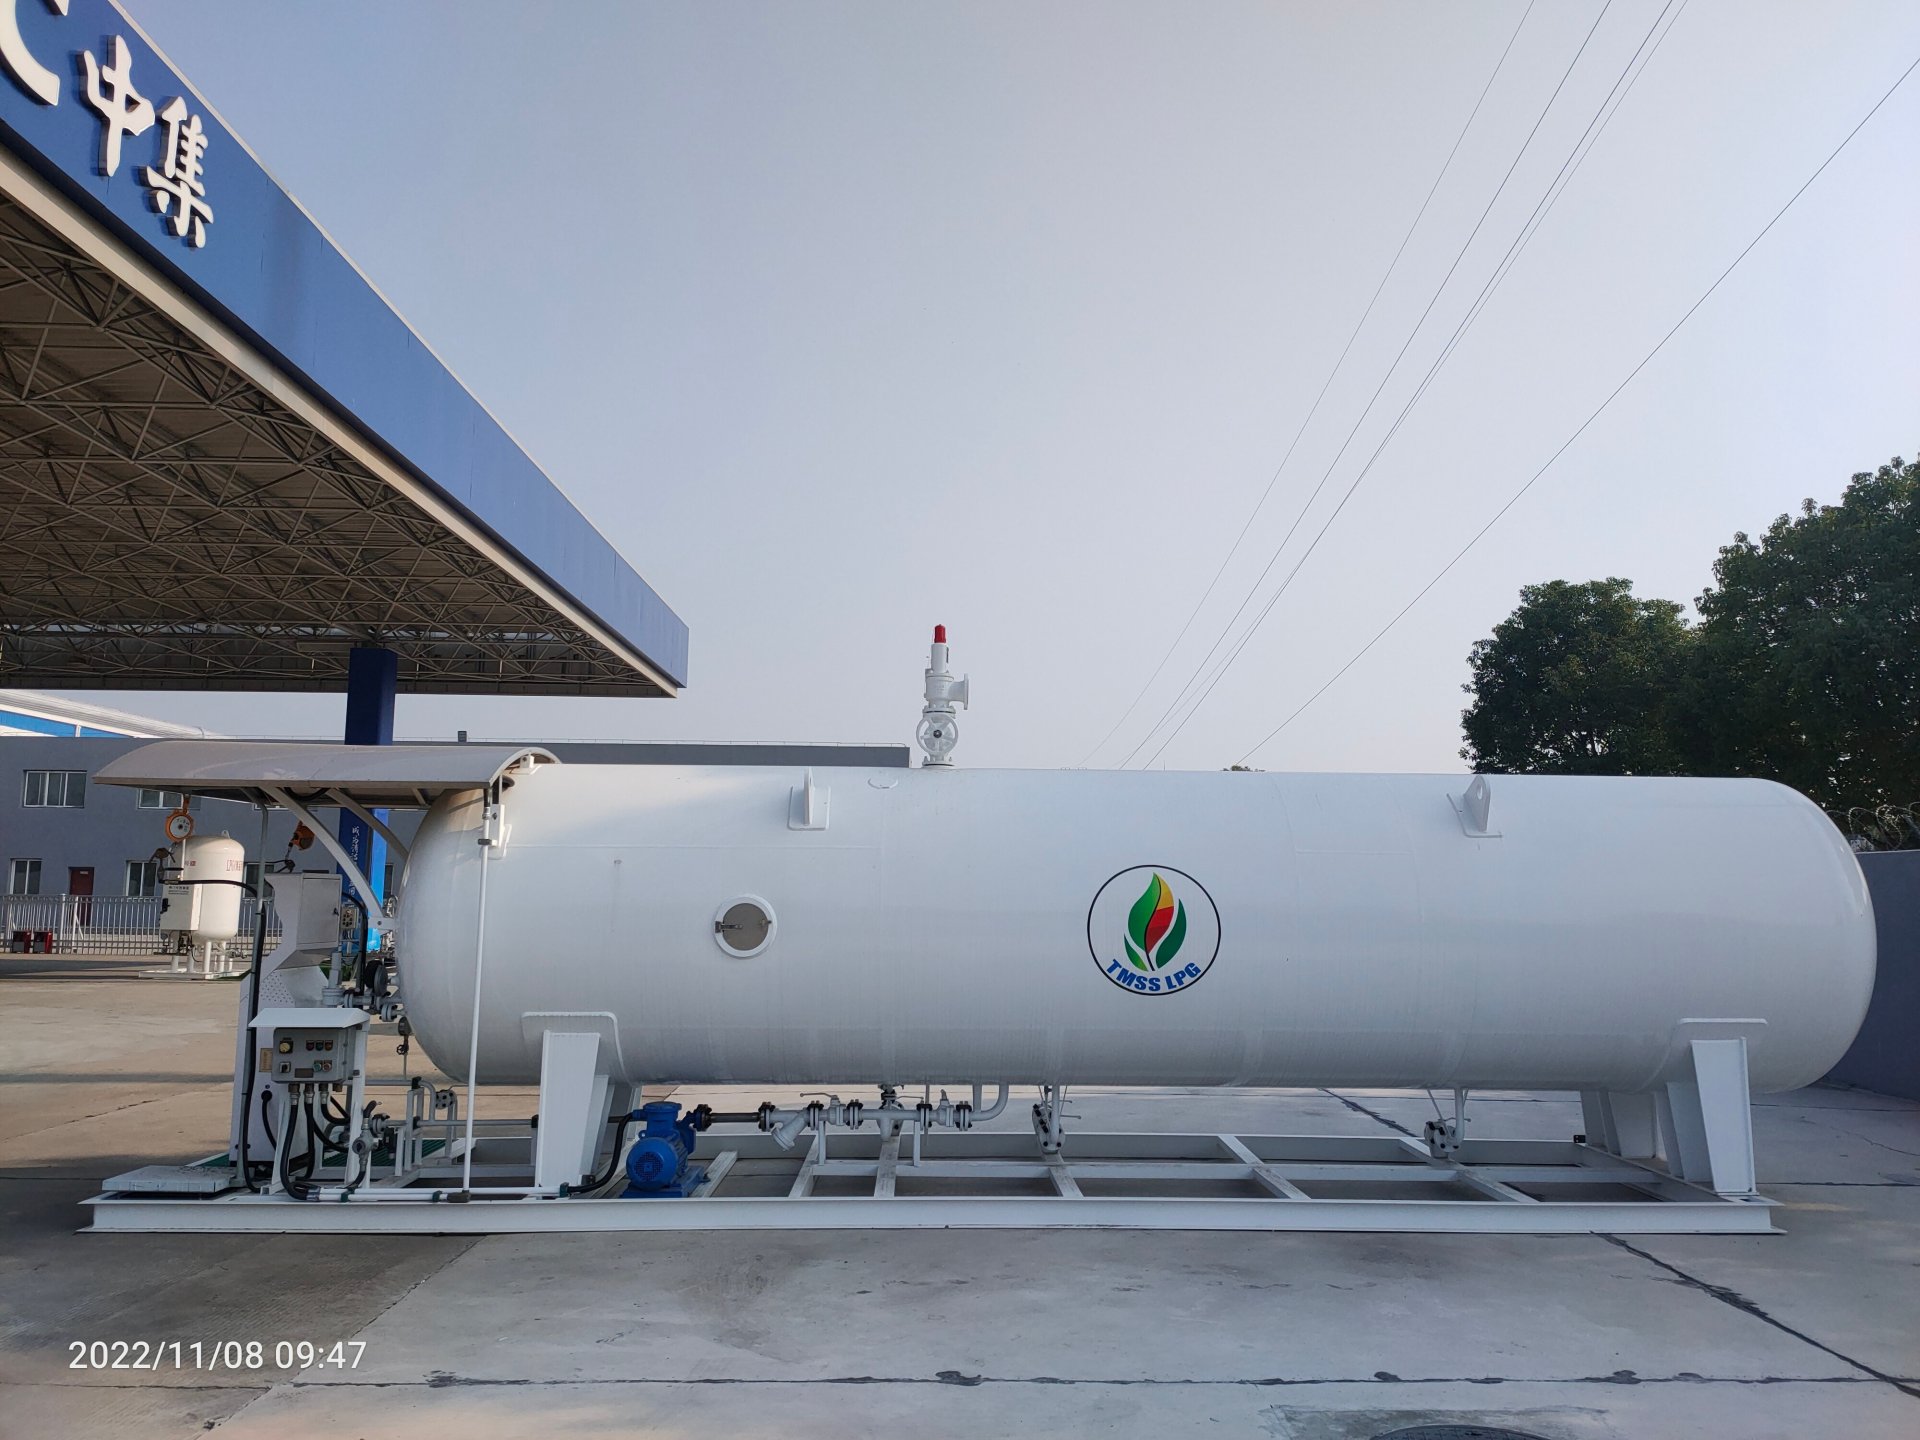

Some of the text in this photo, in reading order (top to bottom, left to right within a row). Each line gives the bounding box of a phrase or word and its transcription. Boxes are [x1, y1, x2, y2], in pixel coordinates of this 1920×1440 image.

[78, 35, 214, 248] 中集
[1106, 958, 1202, 992] TMSS LPG
